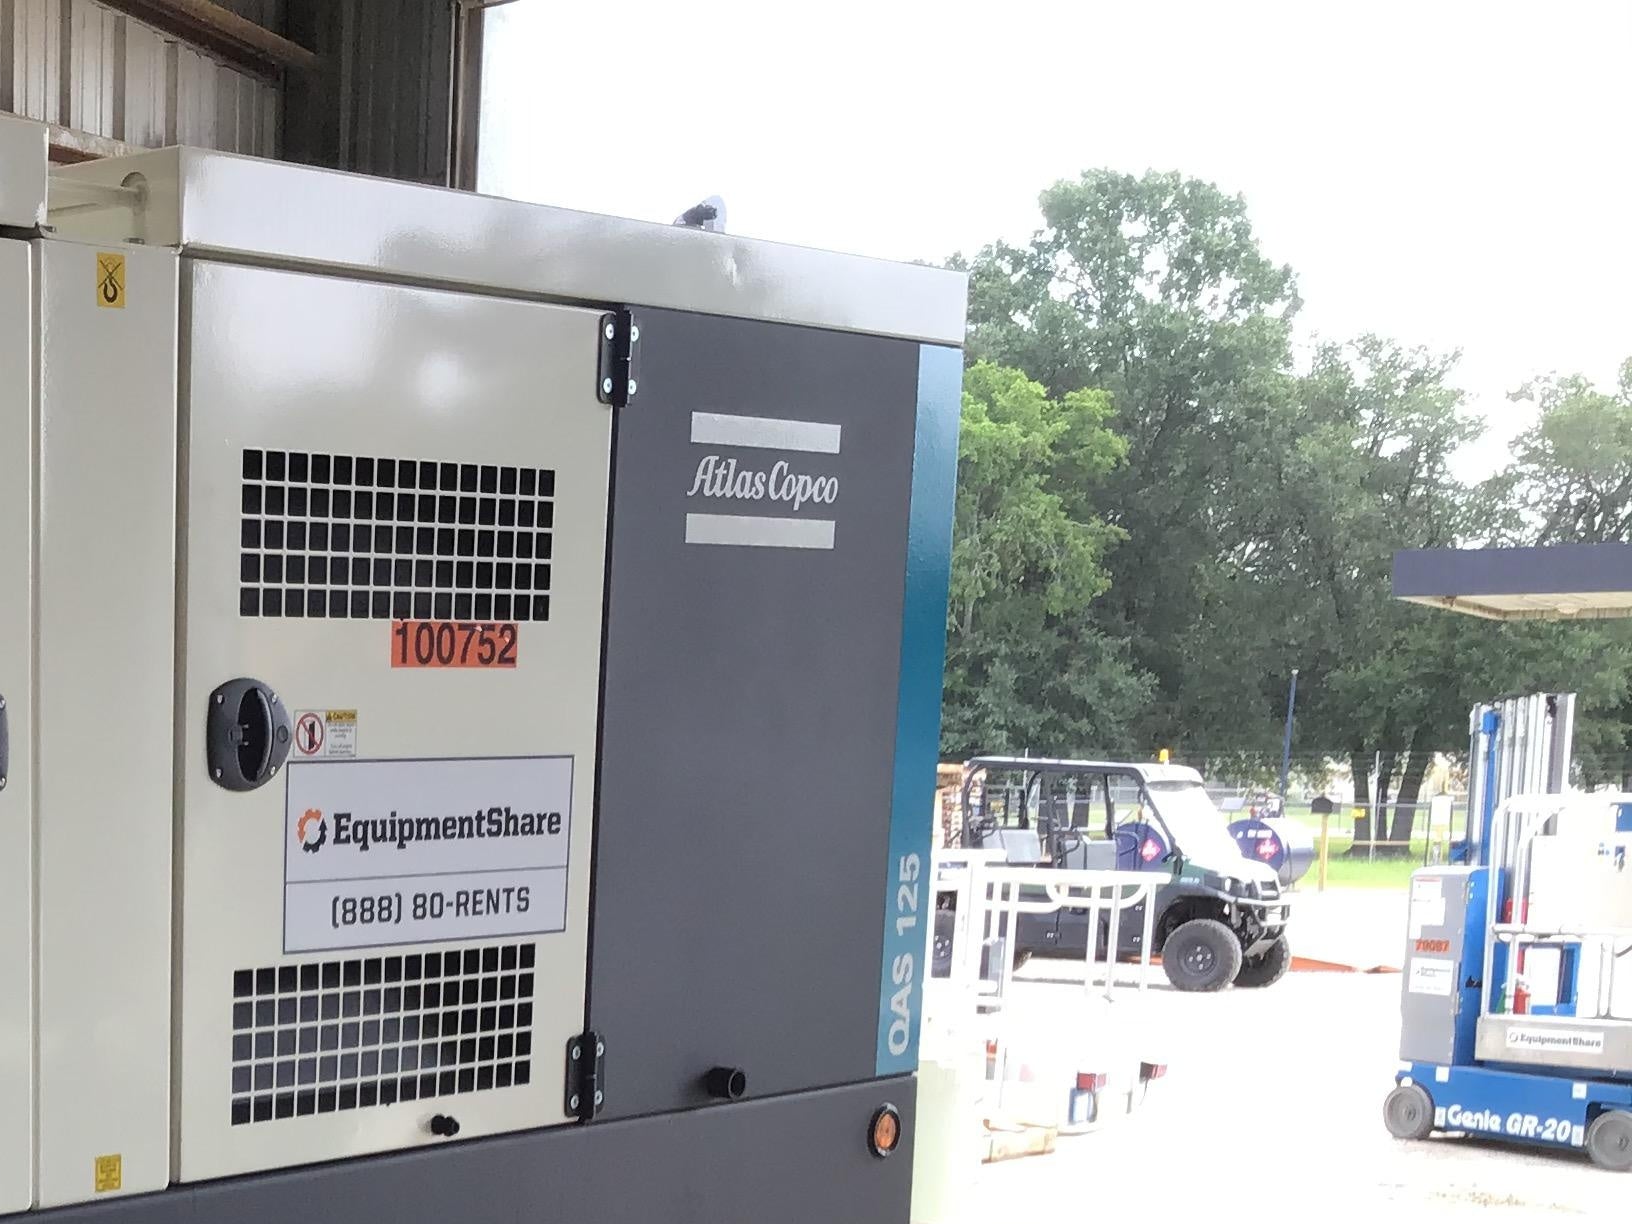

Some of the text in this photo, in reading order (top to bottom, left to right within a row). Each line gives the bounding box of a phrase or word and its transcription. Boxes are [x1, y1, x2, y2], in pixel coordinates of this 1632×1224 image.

[686, 455, 839, 511] Atlas Copco
[395, 621, 517, 666] 100752
[332, 806, 562, 852] EquipmentShare
[331, 886, 531, 928] (888) 80-RENTS
[887, 852, 921, 1056] QAS 125
[1520, 1032, 1601, 1048] EquipmentShare
[1446, 1104, 1570, 1141] Genie GR-20
